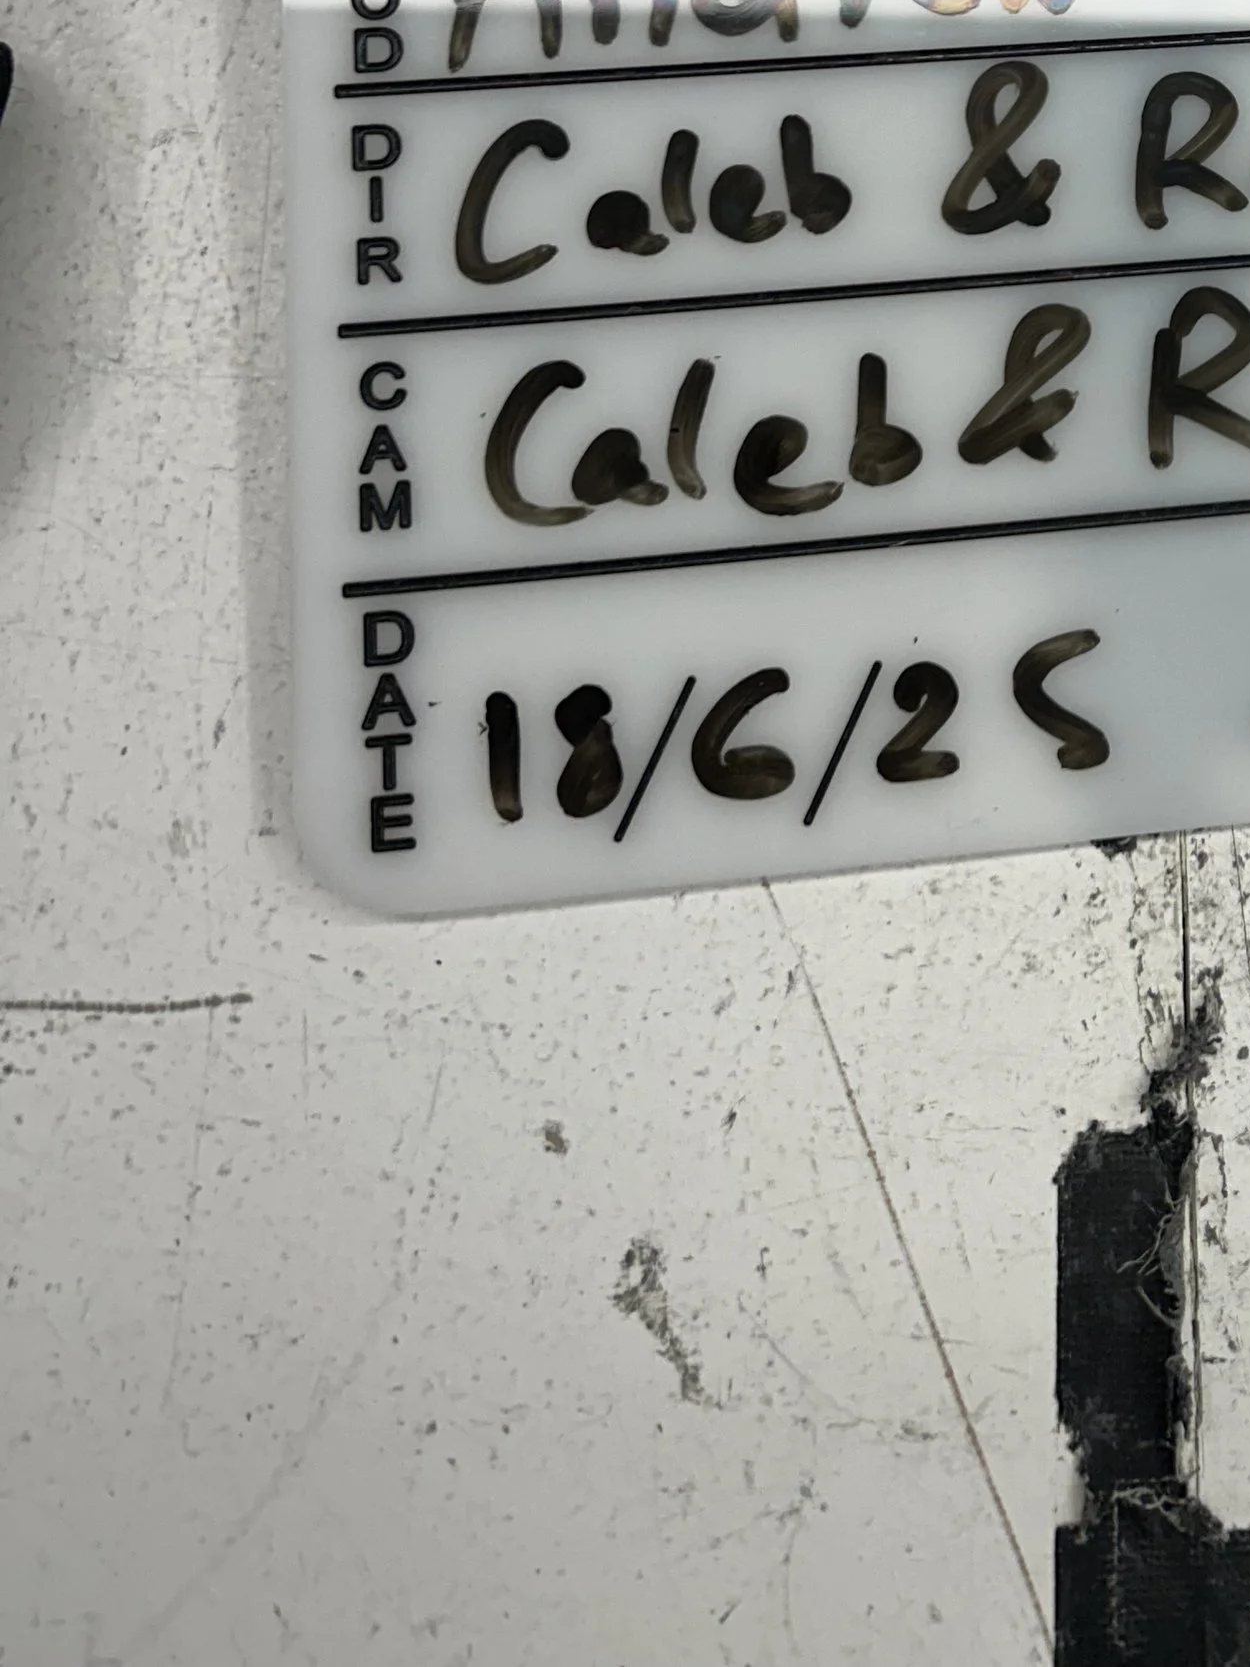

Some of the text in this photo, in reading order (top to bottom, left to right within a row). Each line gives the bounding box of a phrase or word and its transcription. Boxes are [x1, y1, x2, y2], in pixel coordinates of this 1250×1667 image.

[351, 123, 403, 285] DIR
[455, 113, 853, 285] Caleb
[940, 61, 1061, 234] &
[358, 360, 412, 533] CAM
[484, 352, 923, 527] Caleb
[957, 302, 1092, 466] &
[361, 610, 417, 853] DATE
